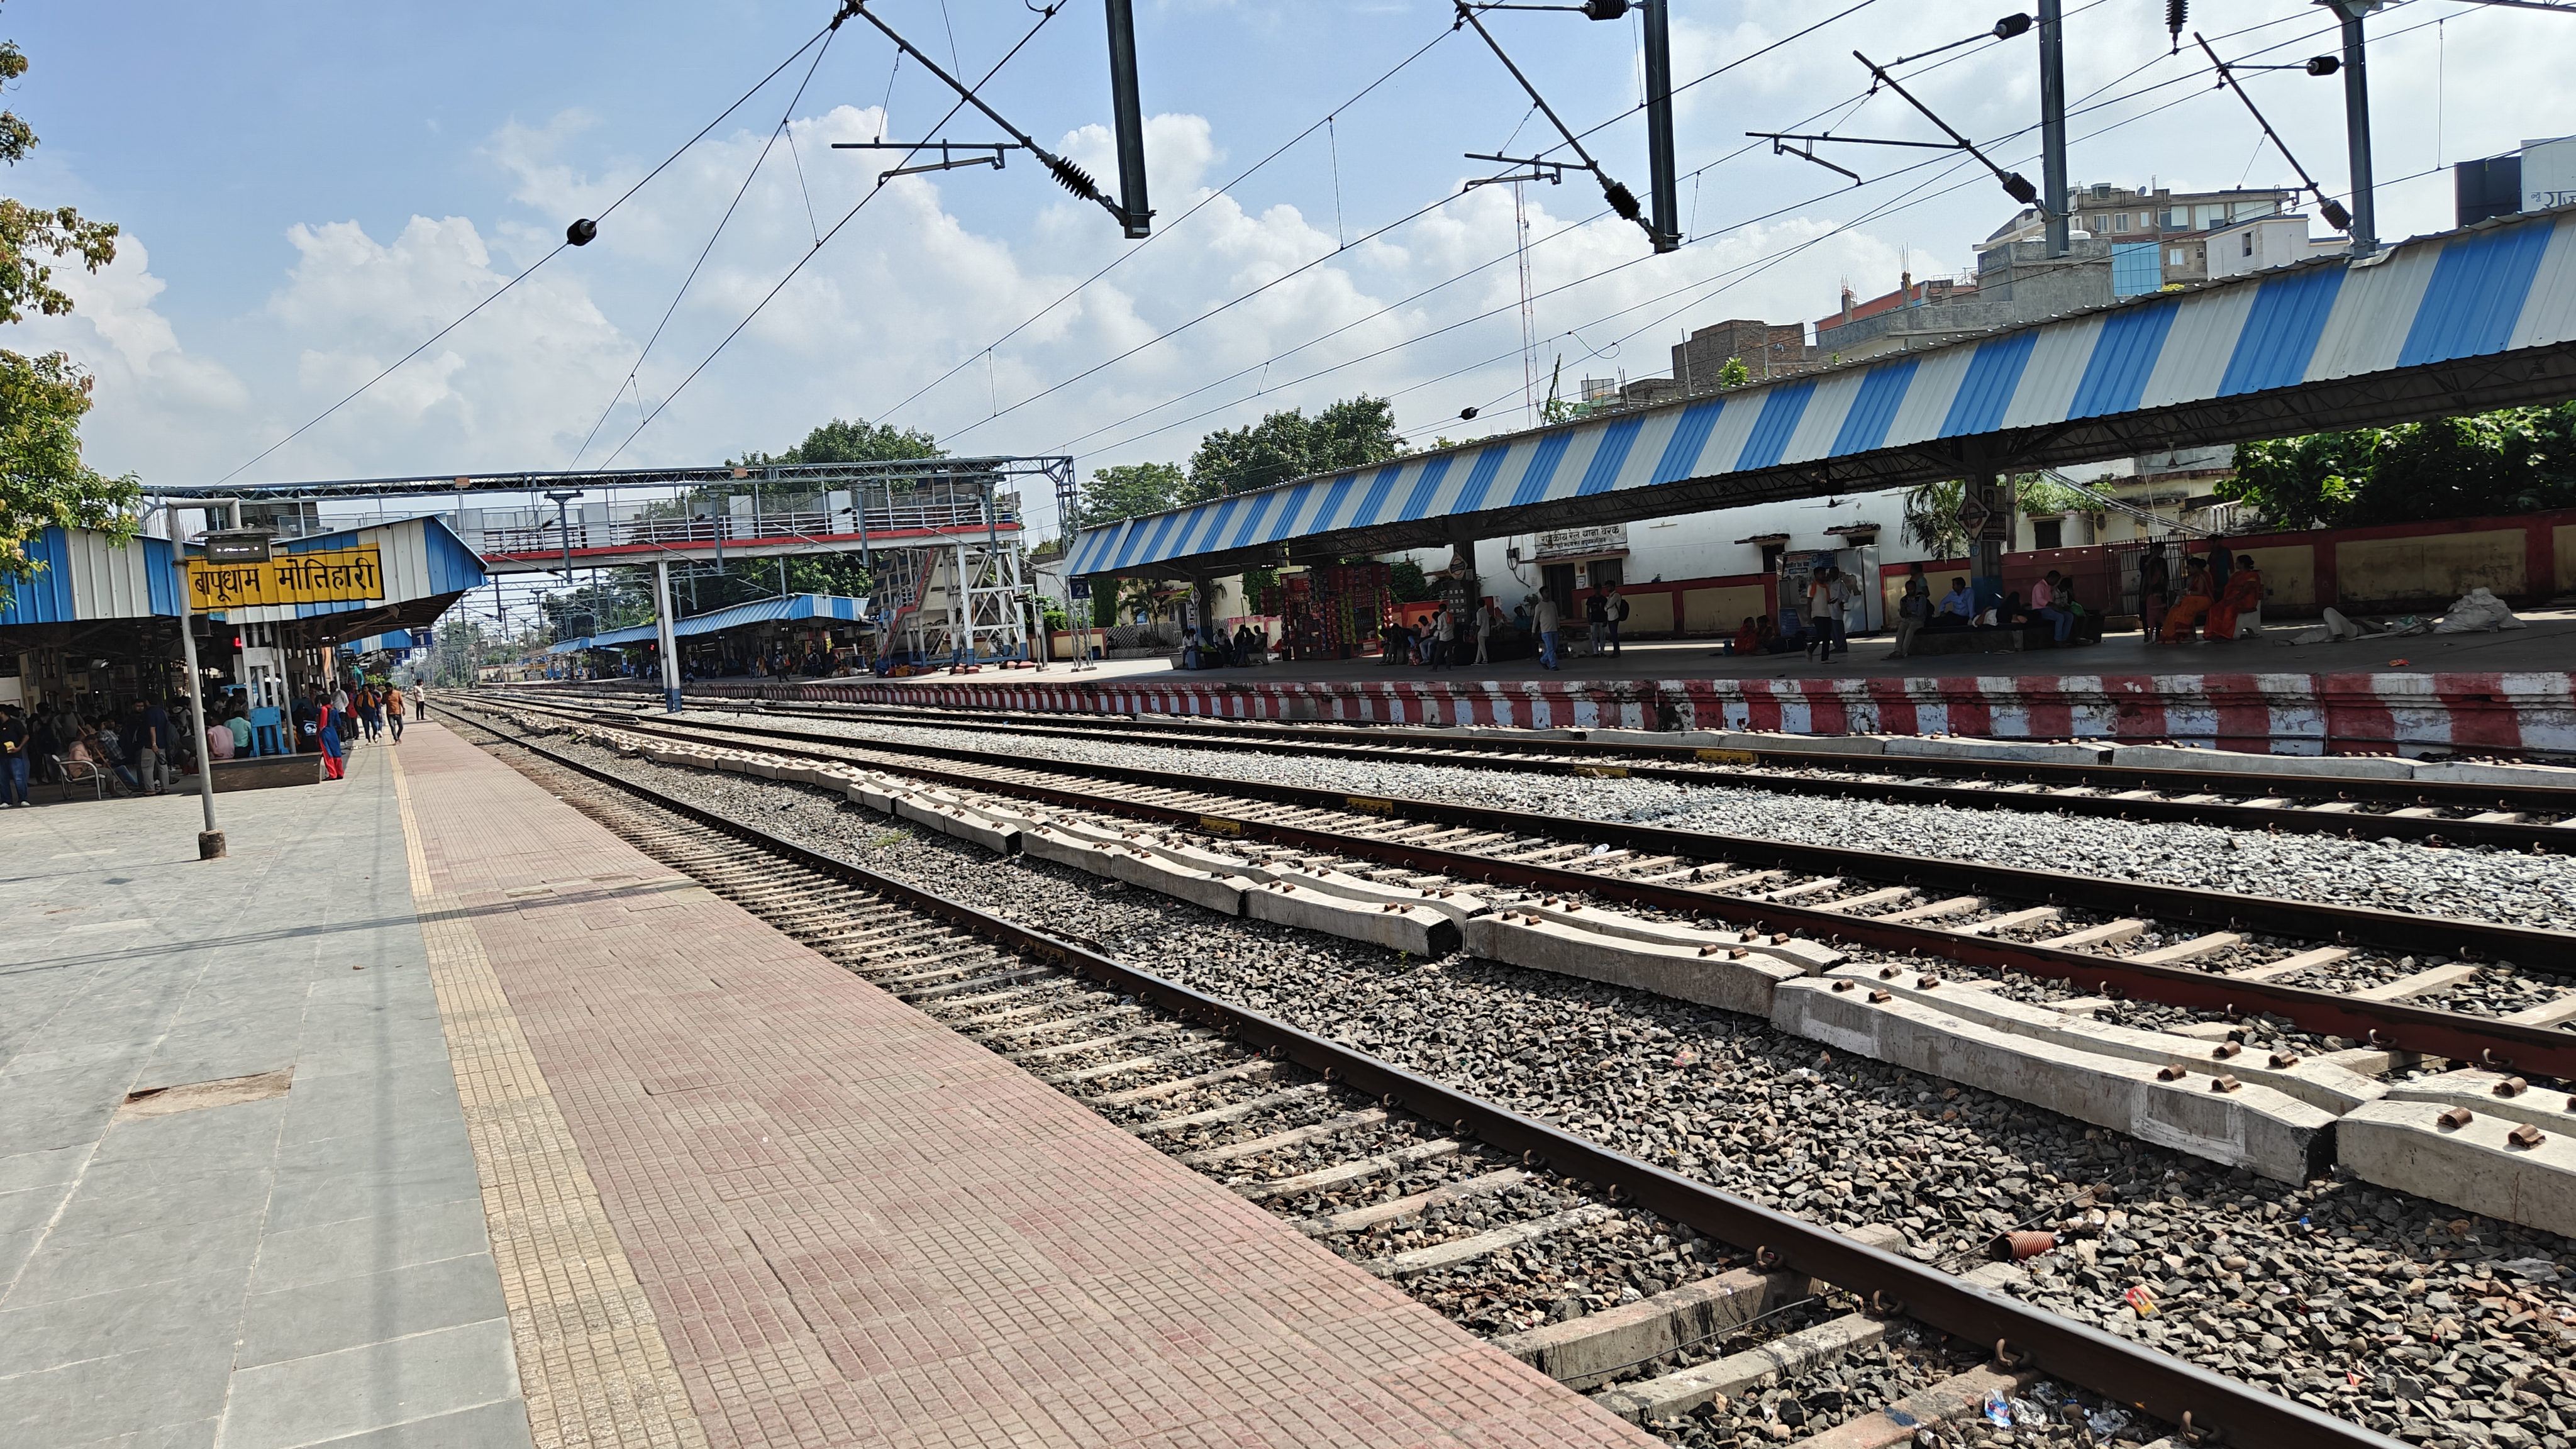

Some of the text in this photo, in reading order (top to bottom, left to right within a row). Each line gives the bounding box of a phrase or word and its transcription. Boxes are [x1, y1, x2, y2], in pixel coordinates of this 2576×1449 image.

[191, 557, 375, 602] बापूधाम मोतिहारी
[1076, 584, 1084, 596] 2
[417, 633, 425, 645] 1
